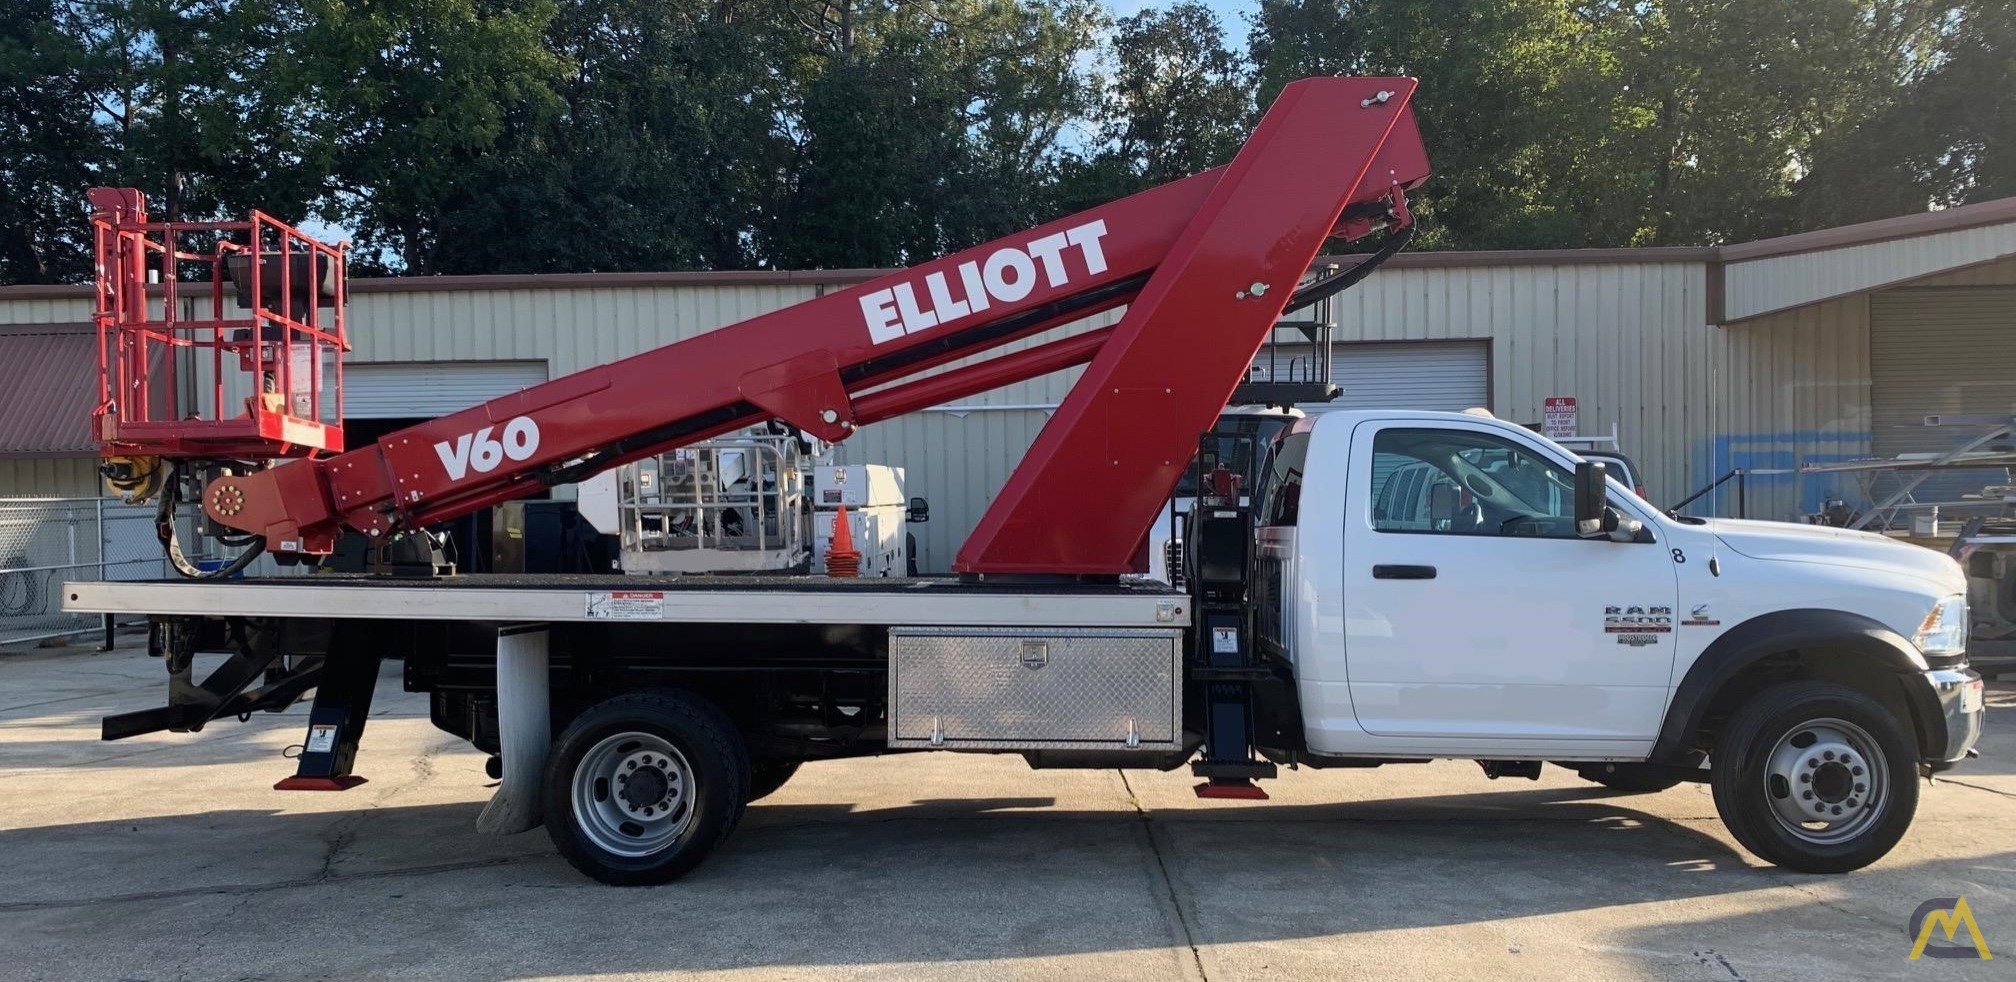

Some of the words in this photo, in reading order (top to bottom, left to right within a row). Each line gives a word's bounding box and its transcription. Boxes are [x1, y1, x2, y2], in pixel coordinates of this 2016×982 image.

[859, 219, 1108, 345] ELLIOTT
[1546, 405, 1576, 413] DELIVERIES
[434, 415, 540, 481] V60
[1671, 548, 1686, 564] 8
[1605, 606, 1671, 615] RAM
[1605, 616, 1671, 626] 5500
